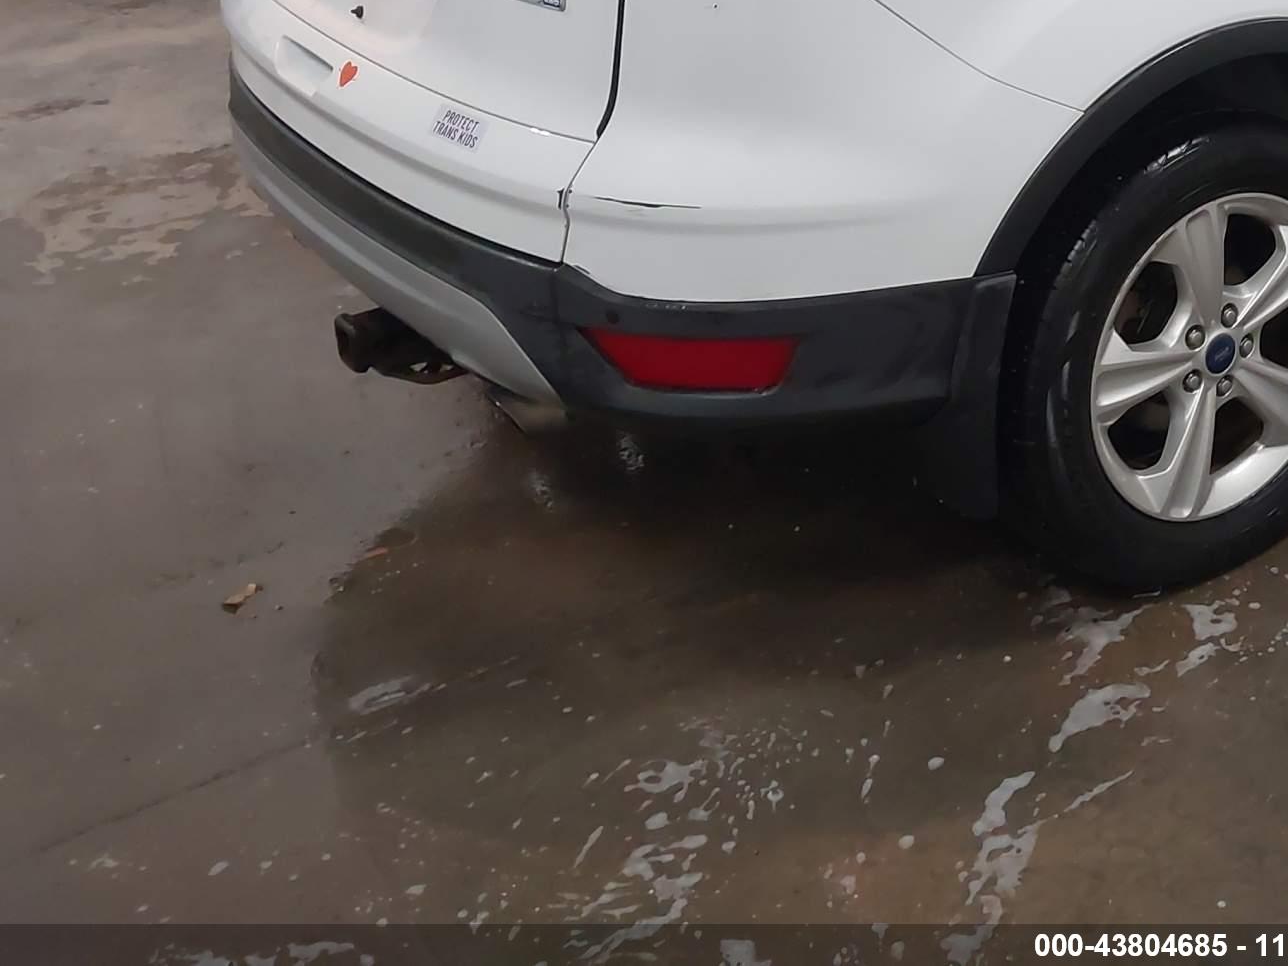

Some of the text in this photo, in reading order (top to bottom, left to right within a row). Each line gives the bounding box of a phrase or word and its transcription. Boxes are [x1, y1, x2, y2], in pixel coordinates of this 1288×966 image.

[442, 109, 480, 134] PROTECT
[433, 121, 479, 149] TRANS KIDS
